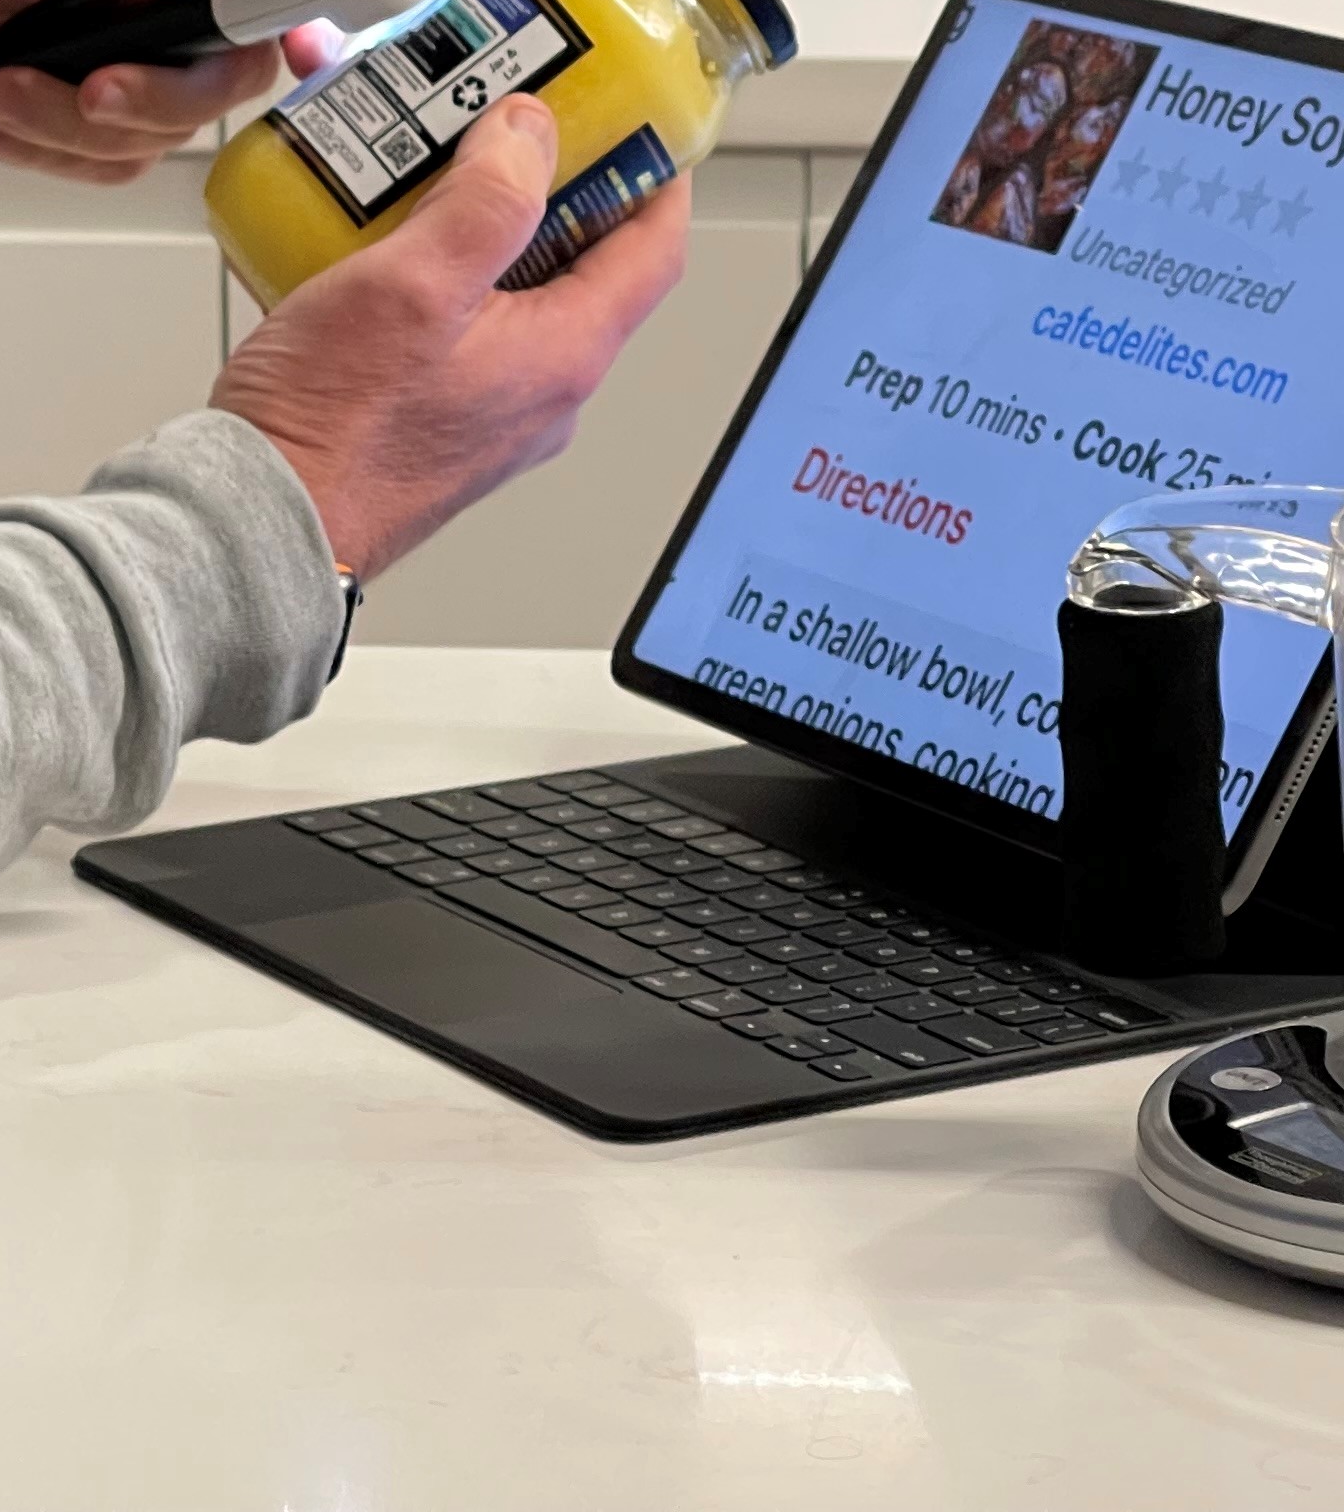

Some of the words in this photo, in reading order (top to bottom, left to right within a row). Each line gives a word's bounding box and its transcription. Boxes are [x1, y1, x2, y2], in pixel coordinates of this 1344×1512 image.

[1146, 63, 1284, 148] Honey
[1070, 226, 1294, 316] Uncategorized
[1032, 301, 1289, 405] cafedelites.com
[845, 349, 924, 413] Prep
[928, 374, 970, 419] 10
[968, 396, 1047, 445] mins
[1072, 419, 1167, 484] Cook
[1164, 448, 1223, 492] 25
[792, 447, 974, 545] Directions
[725, 574, 762, 624] In
[762, 600, 785, 633] a
[788, 602, 921, 681] shallow
[918, 644, 1016, 727] bowl,
[1015, 684, 1064, 738] co
[694, 656, 788, 714] green
[912, 740, 1057, 817] cooking
